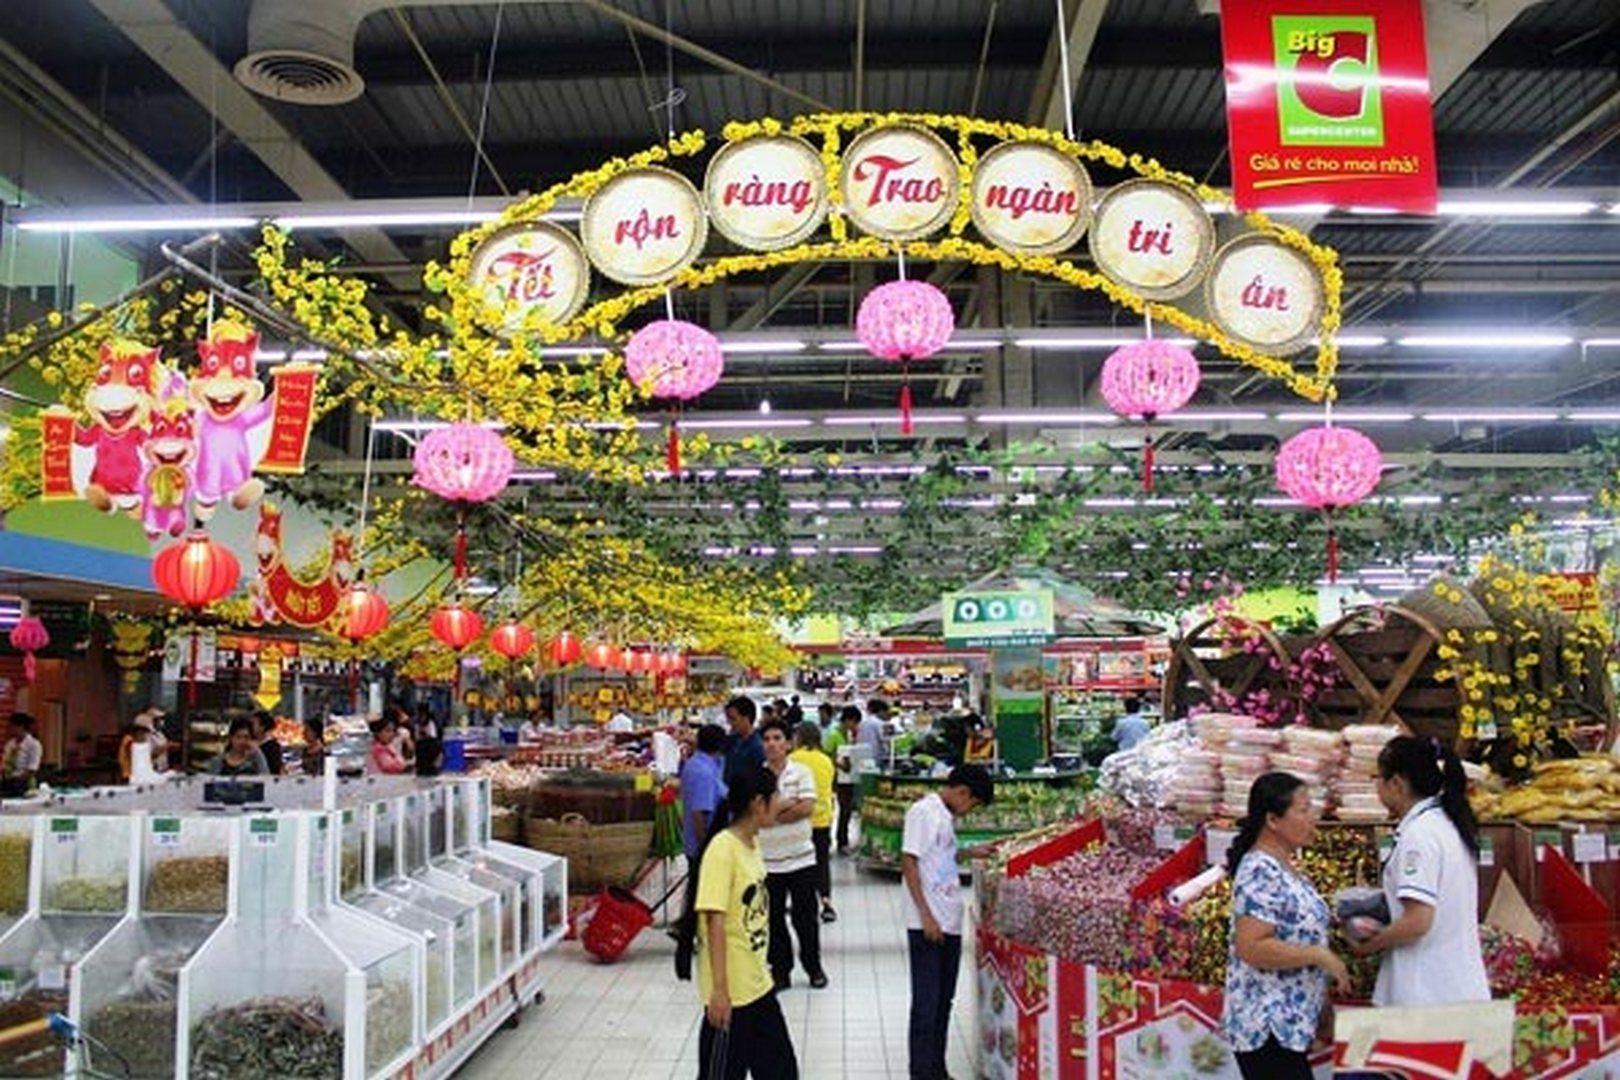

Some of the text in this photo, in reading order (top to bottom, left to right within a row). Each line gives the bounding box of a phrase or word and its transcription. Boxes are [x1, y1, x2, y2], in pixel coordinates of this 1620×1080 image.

[1288, 29, 1335, 57] Big
[1250, 153, 1280, 171] Giá
[1306, 155, 1340, 171] cho
[615, 208, 681, 250] rộn
[723, 174, 813, 214] ràng
[853, 155, 946, 208] Trao
[985, 181, 1080, 219] ngàn
[1127, 219, 1174, 255] tri
[1242, 274, 1290, 312] ân
